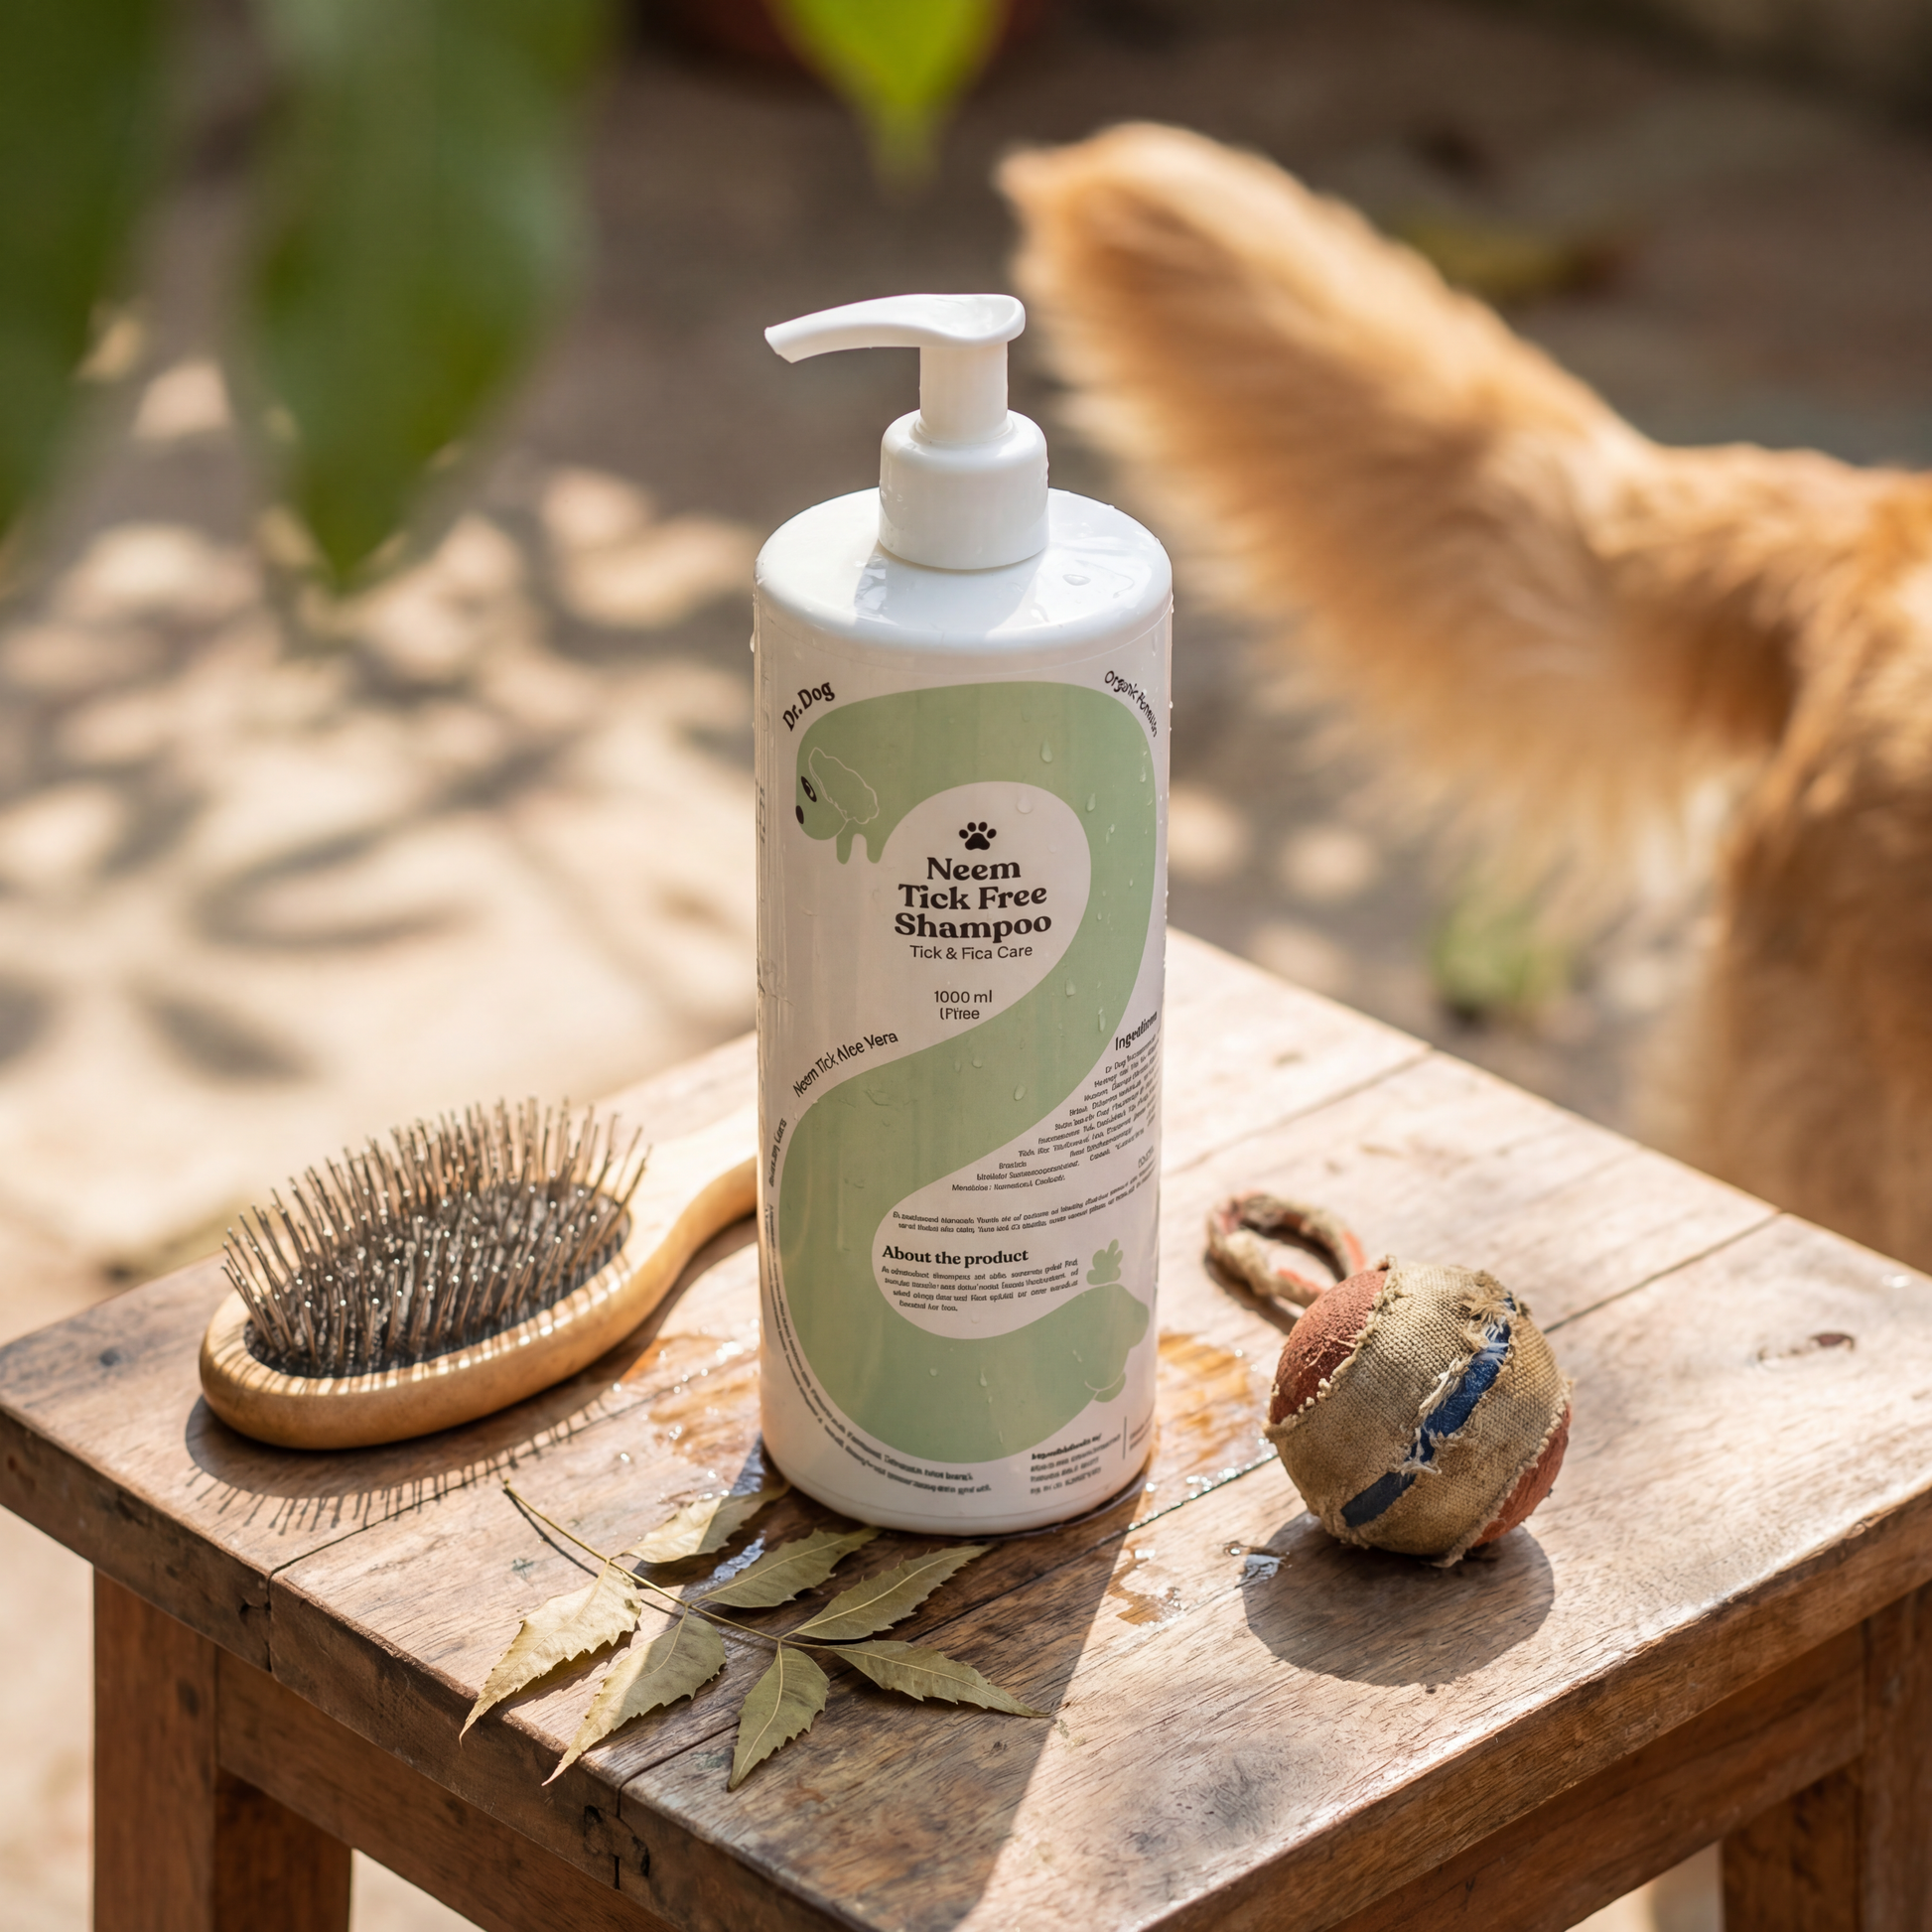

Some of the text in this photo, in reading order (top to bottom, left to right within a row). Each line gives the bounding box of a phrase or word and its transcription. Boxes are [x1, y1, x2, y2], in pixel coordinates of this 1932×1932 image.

[782, 681, 836, 732] Dr. Dog
[926, 857, 1022, 881] Neem
[897, 883, 1047, 910] Tick Free
[894, 912, 1052, 944] Shampoo
[909, 944, 942, 960] Tick
[945, 946, 958, 960] &
[997, 945, 1034, 959] Care
[933, 989, 993, 1004] 1000 ml
[863, 1033, 899, 1049] Vera
[882, 1245, 1030, 1269] About the product
